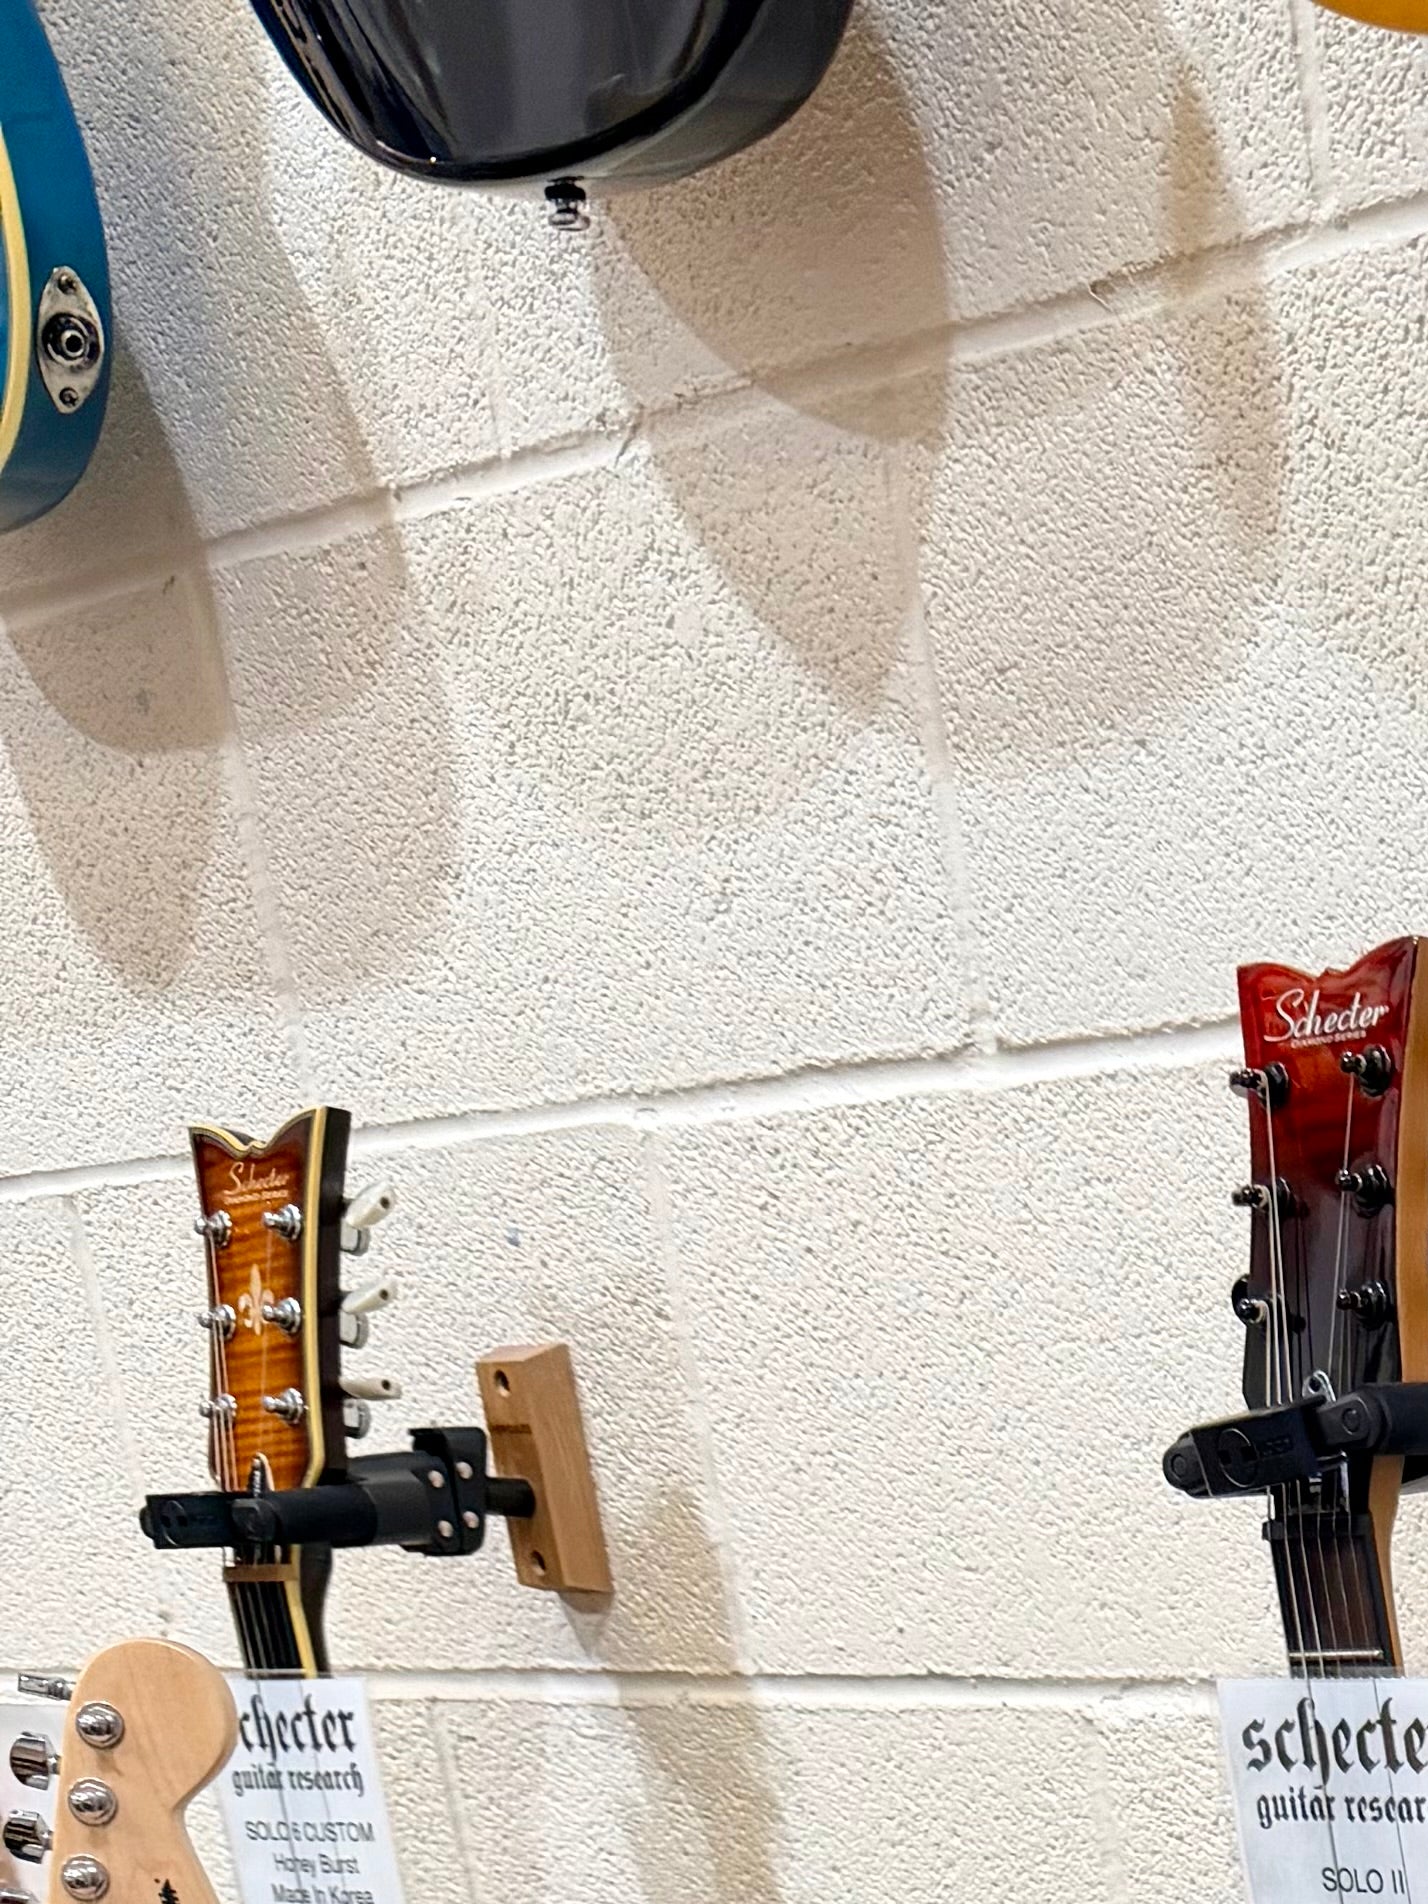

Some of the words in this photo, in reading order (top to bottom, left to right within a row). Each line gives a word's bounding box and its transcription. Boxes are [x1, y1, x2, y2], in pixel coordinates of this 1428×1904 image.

[1263, 987, 1390, 1043] Schecter
[239, 1694, 356, 1762] checter
[232, 1761, 284, 1798] guitar
[287, 1761, 365, 1798] research
[1256, 1786, 1337, 1831] guitar
[303, 1820, 376, 1843] CUSTOM
[318, 1853, 361, 1874] Burst
[1321, 1867, 1385, 1896] SOLO
[1391, 1869, 1406, 1895] II
